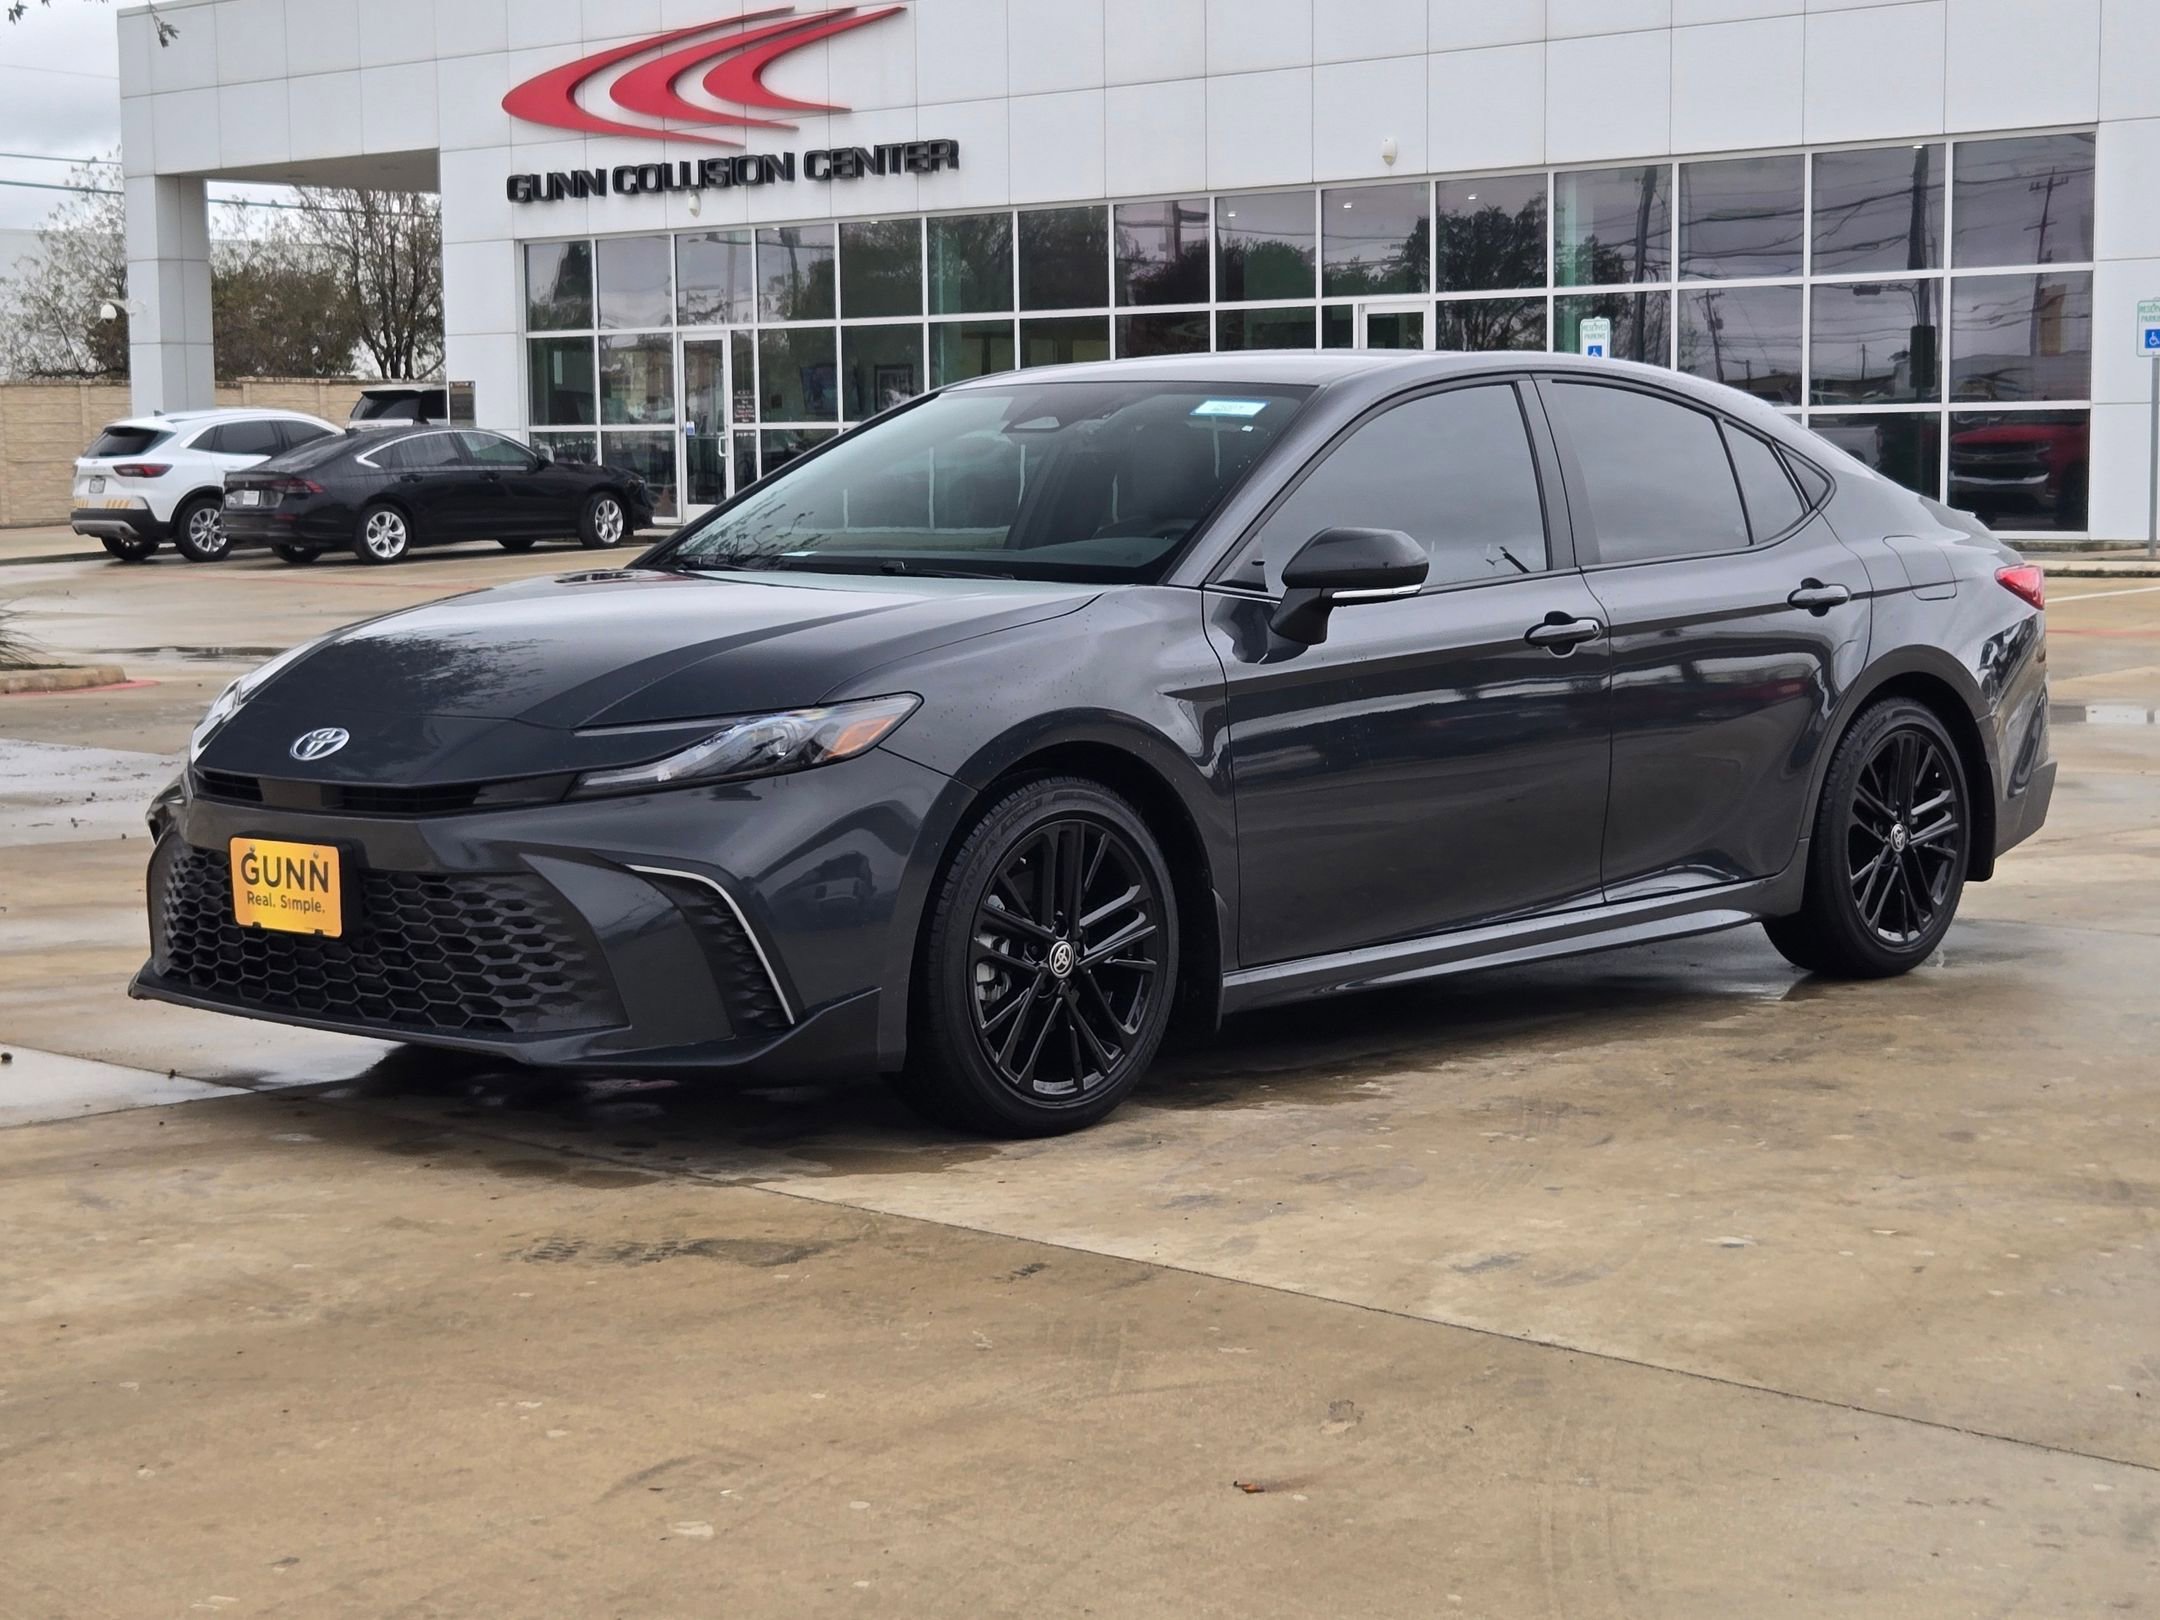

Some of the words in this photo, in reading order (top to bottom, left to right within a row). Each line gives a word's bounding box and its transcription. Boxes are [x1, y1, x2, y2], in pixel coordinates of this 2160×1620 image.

[506, 168, 607, 203] GUNN
[612, 152, 796, 195] COLLISION
[804, 138, 960, 181] CENTER
[240, 852, 329, 893] GUNN
[247, 890, 276, 908] Real.
[280, 894, 326, 914] Simple.
